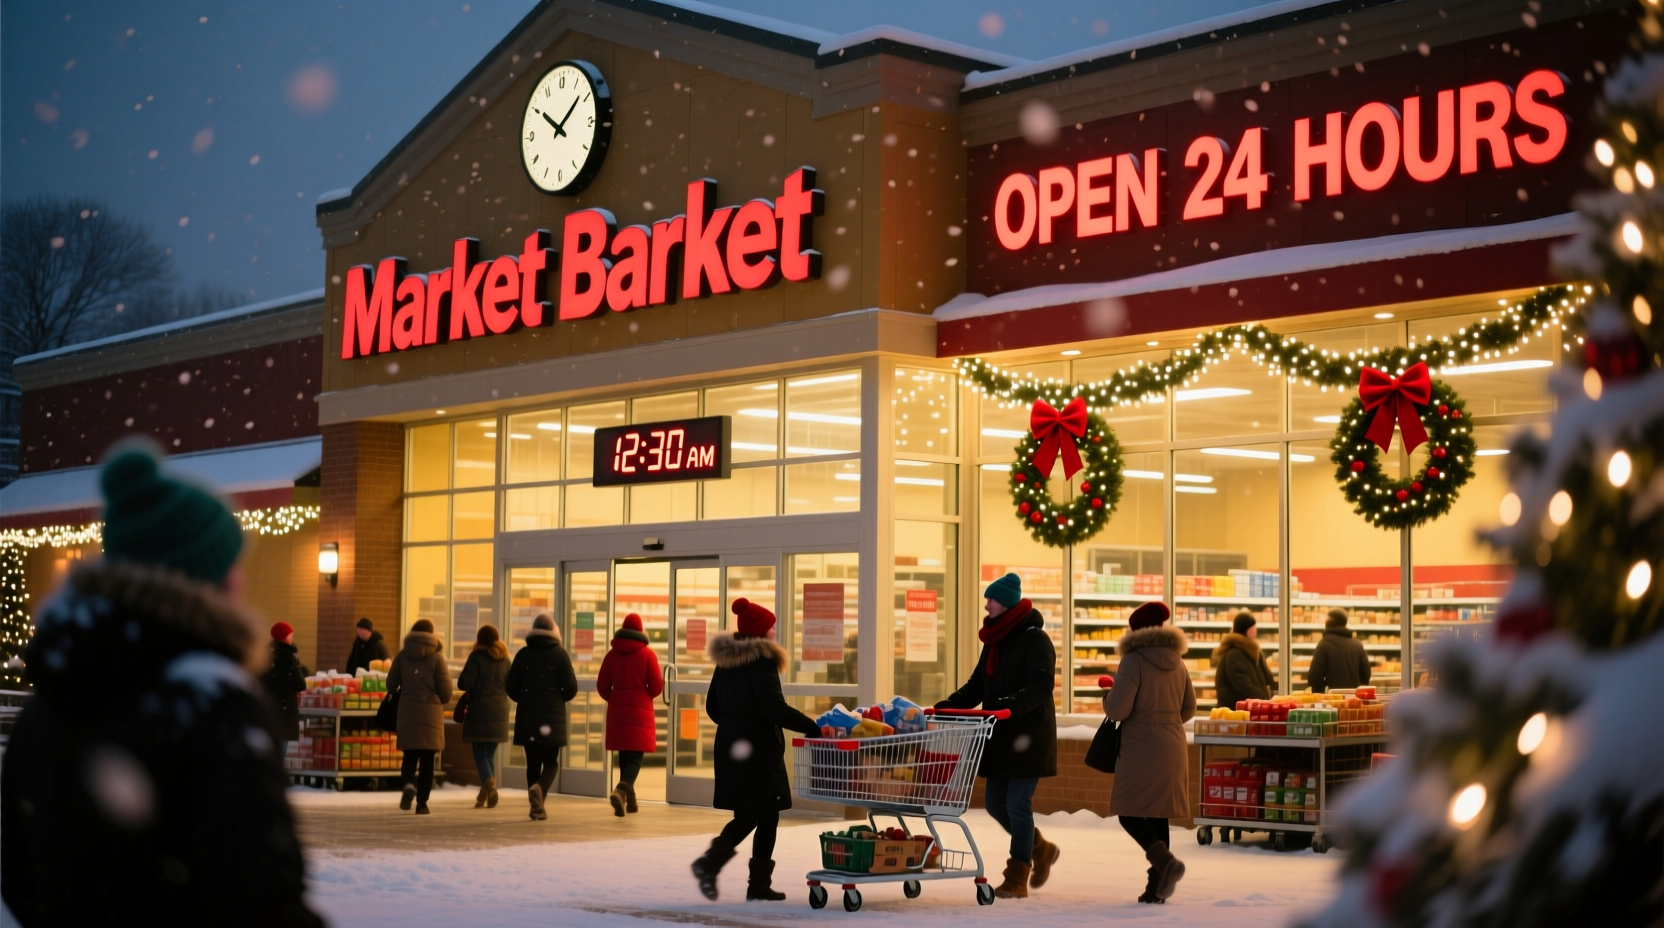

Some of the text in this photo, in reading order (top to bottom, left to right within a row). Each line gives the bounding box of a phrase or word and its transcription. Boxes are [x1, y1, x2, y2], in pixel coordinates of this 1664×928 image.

[994, 69, 1568, 250] OPEN 24 HOURS
[341, 167, 816, 359] Market Barket
[614, 429, 715, 472] 12:30 AM
